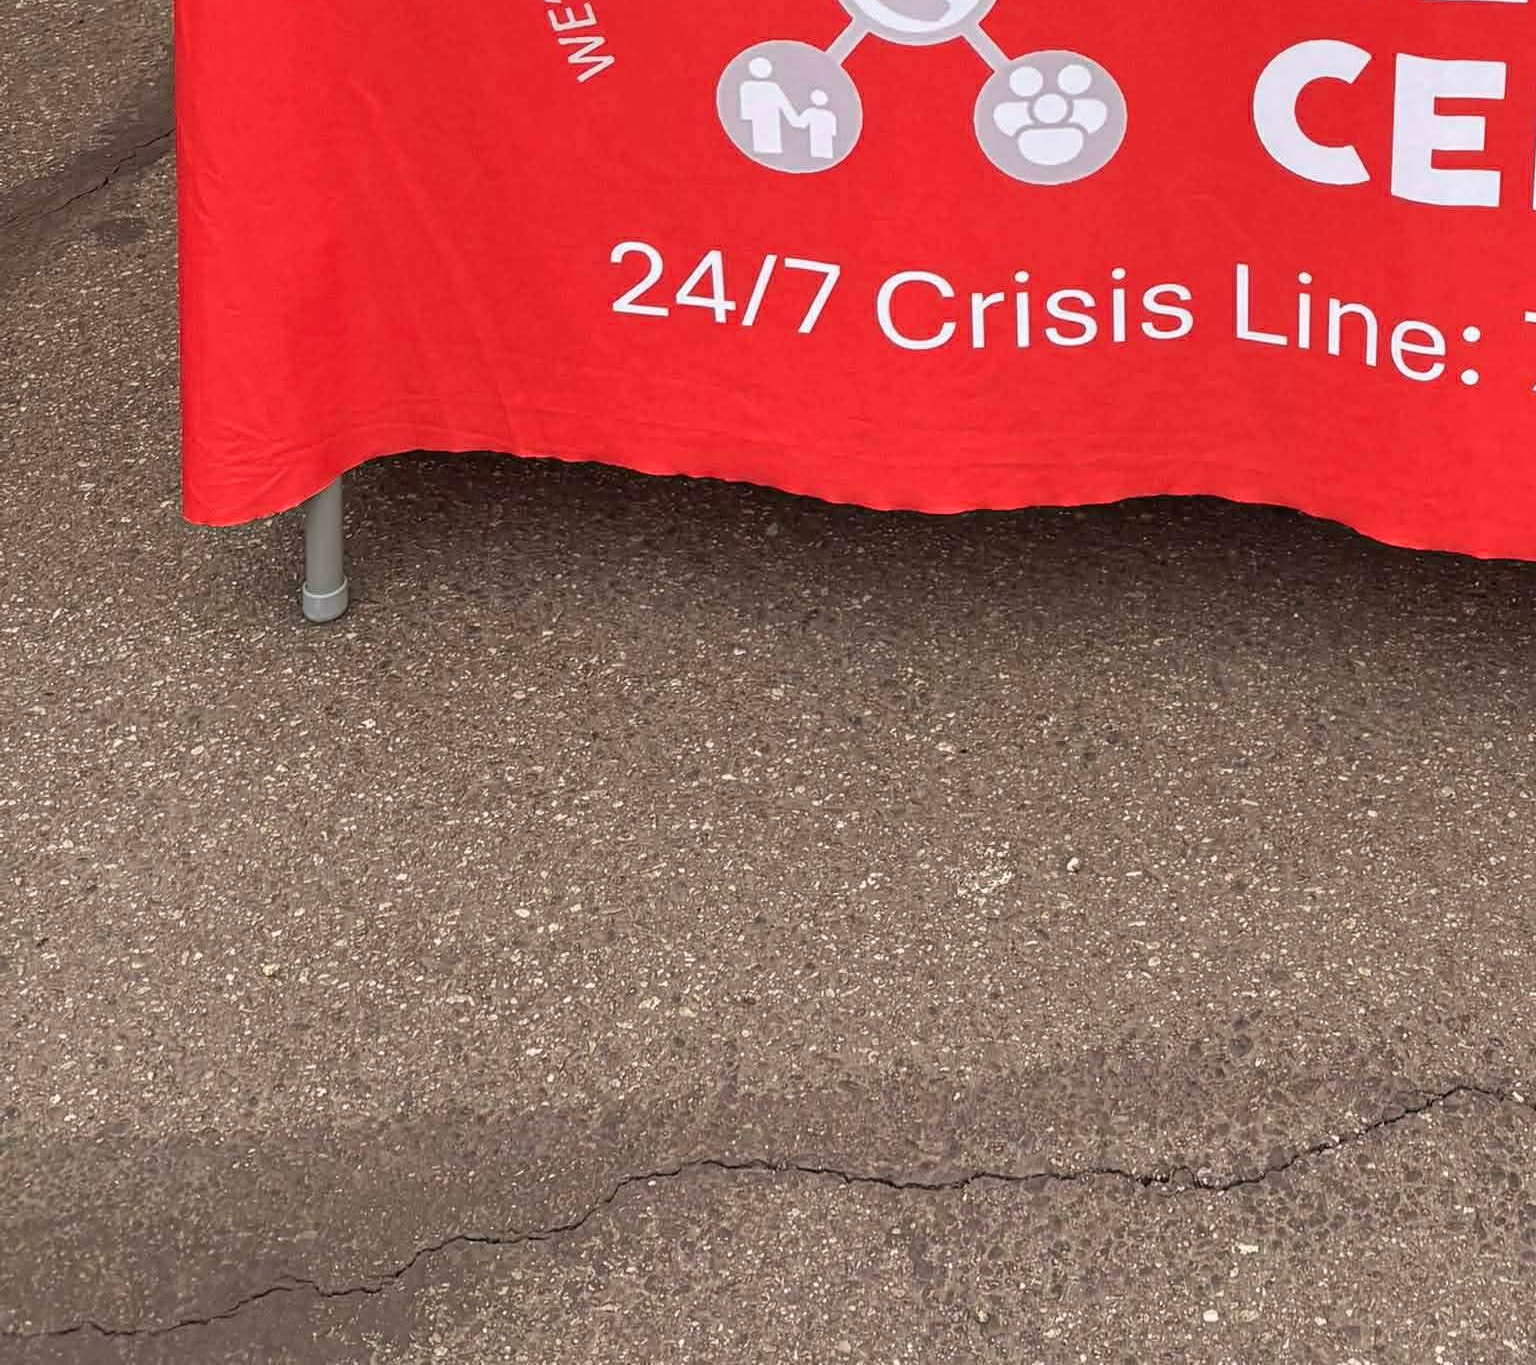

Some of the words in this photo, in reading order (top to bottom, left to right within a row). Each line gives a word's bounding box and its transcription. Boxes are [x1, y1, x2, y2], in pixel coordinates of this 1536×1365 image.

[609, 240, 842, 335] 24/7
[876, 267, 1194, 351] Crisis
[1234, 262, 1483, 386] Line:
